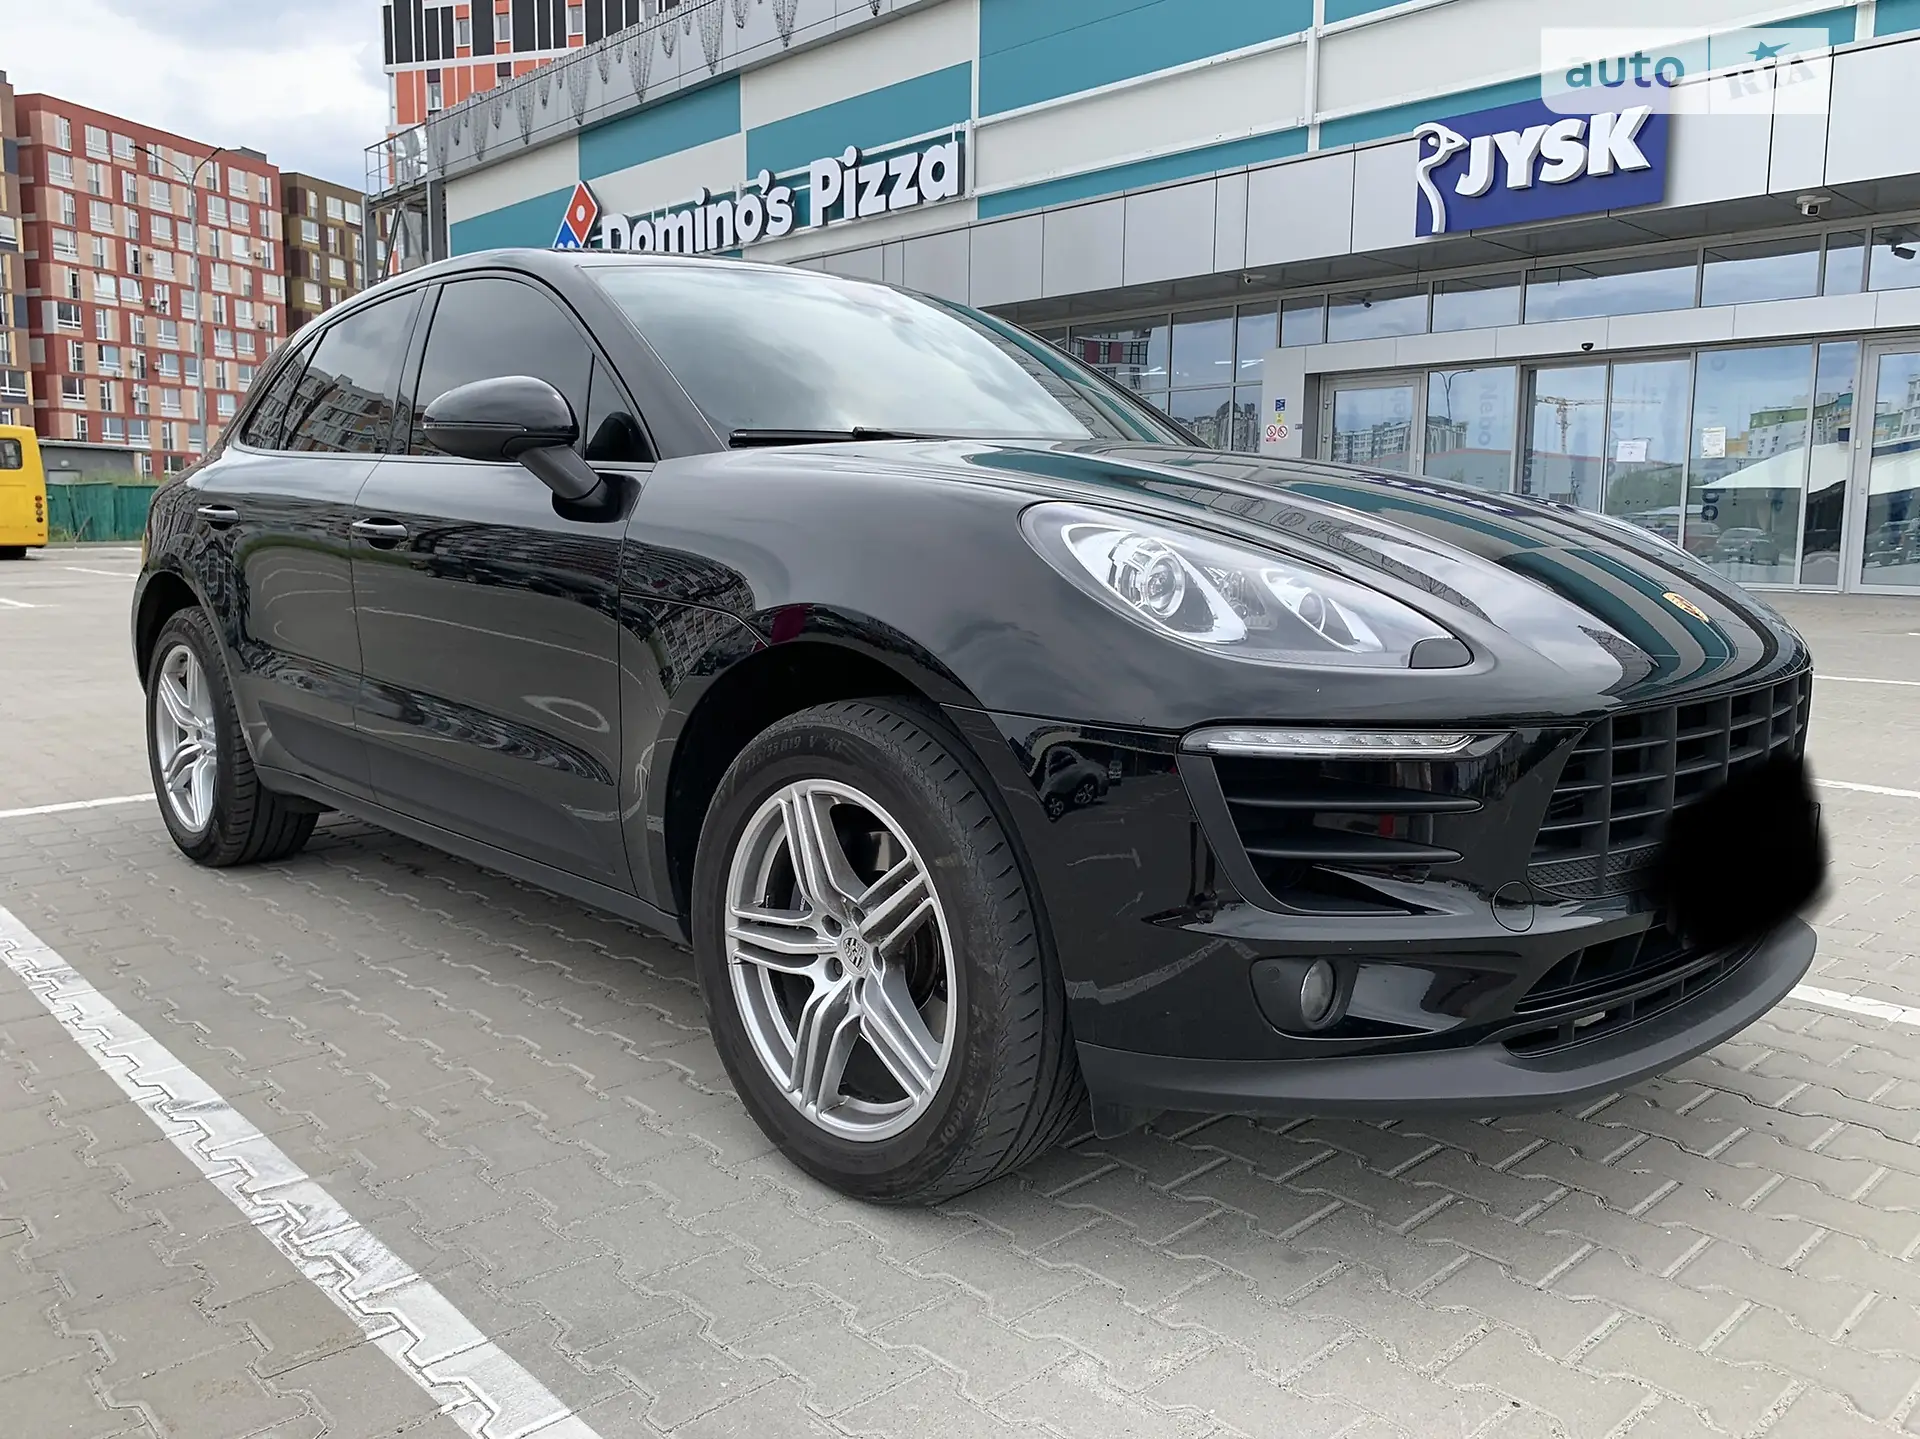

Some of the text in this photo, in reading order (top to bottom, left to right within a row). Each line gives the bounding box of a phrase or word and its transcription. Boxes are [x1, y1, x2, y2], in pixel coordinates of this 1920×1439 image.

[602, 141, 961, 253] Domino's Pizza
[1455, 104, 1655, 197] JYSK
